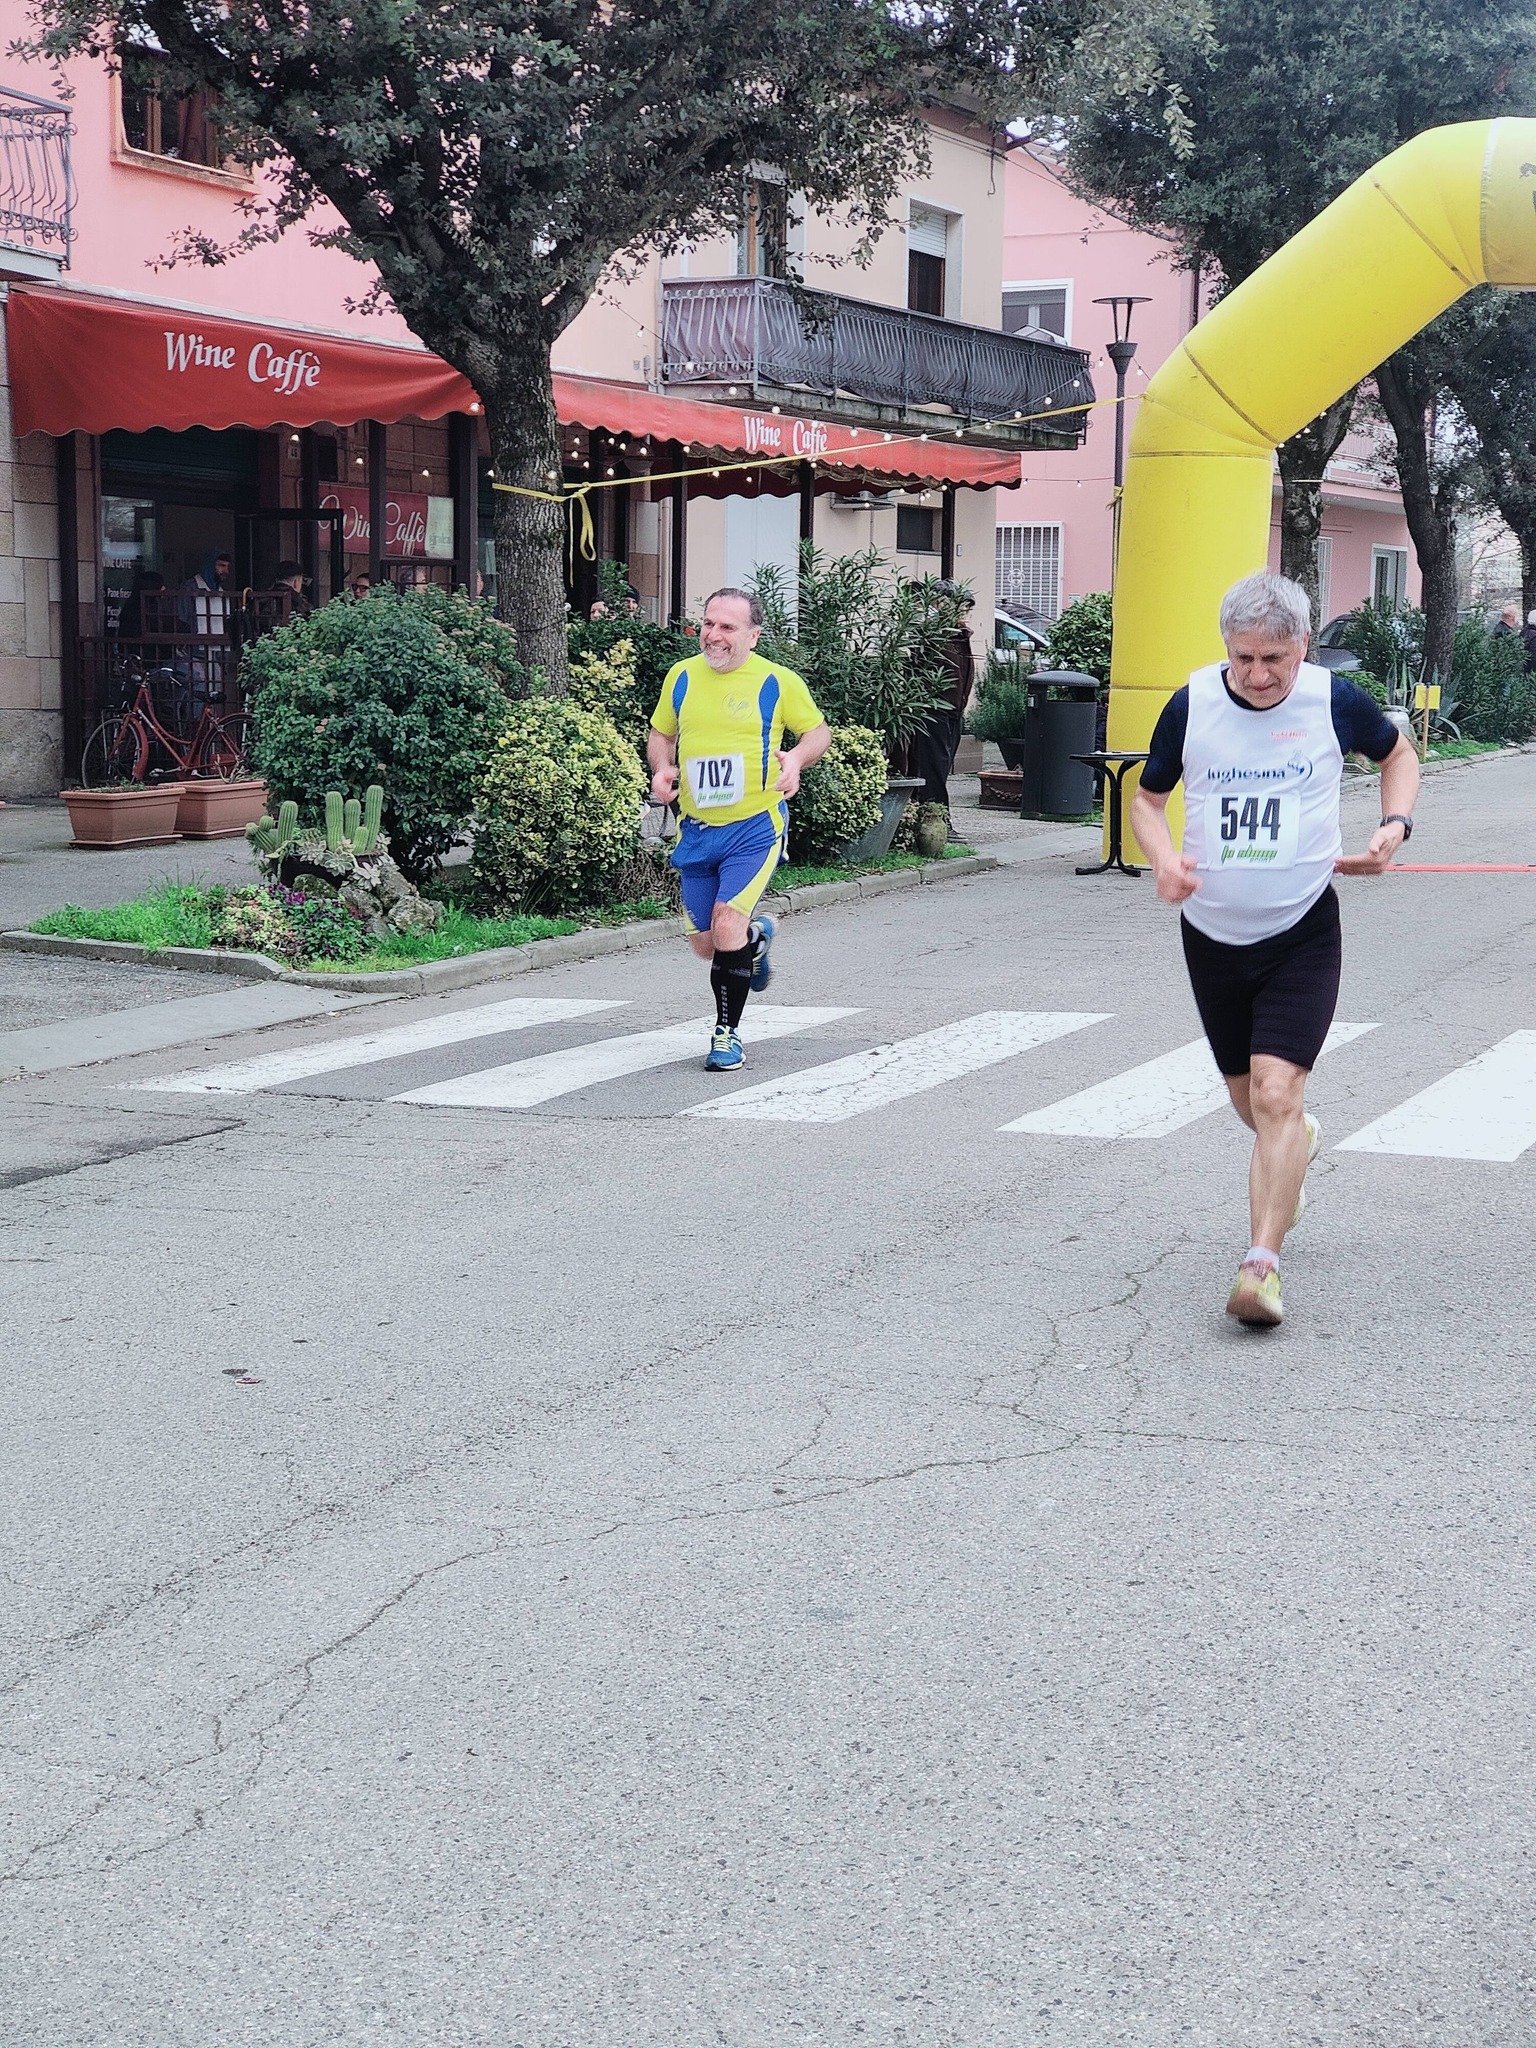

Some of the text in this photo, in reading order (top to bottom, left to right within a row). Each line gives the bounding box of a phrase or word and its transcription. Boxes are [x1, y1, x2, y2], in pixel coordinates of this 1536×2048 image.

[163, 331, 321, 396] Wine Caffè
[743, 416, 828, 462] Wine Caffè
[696, 758, 735, 789] 702
[1220, 797, 1281, 841] 544
